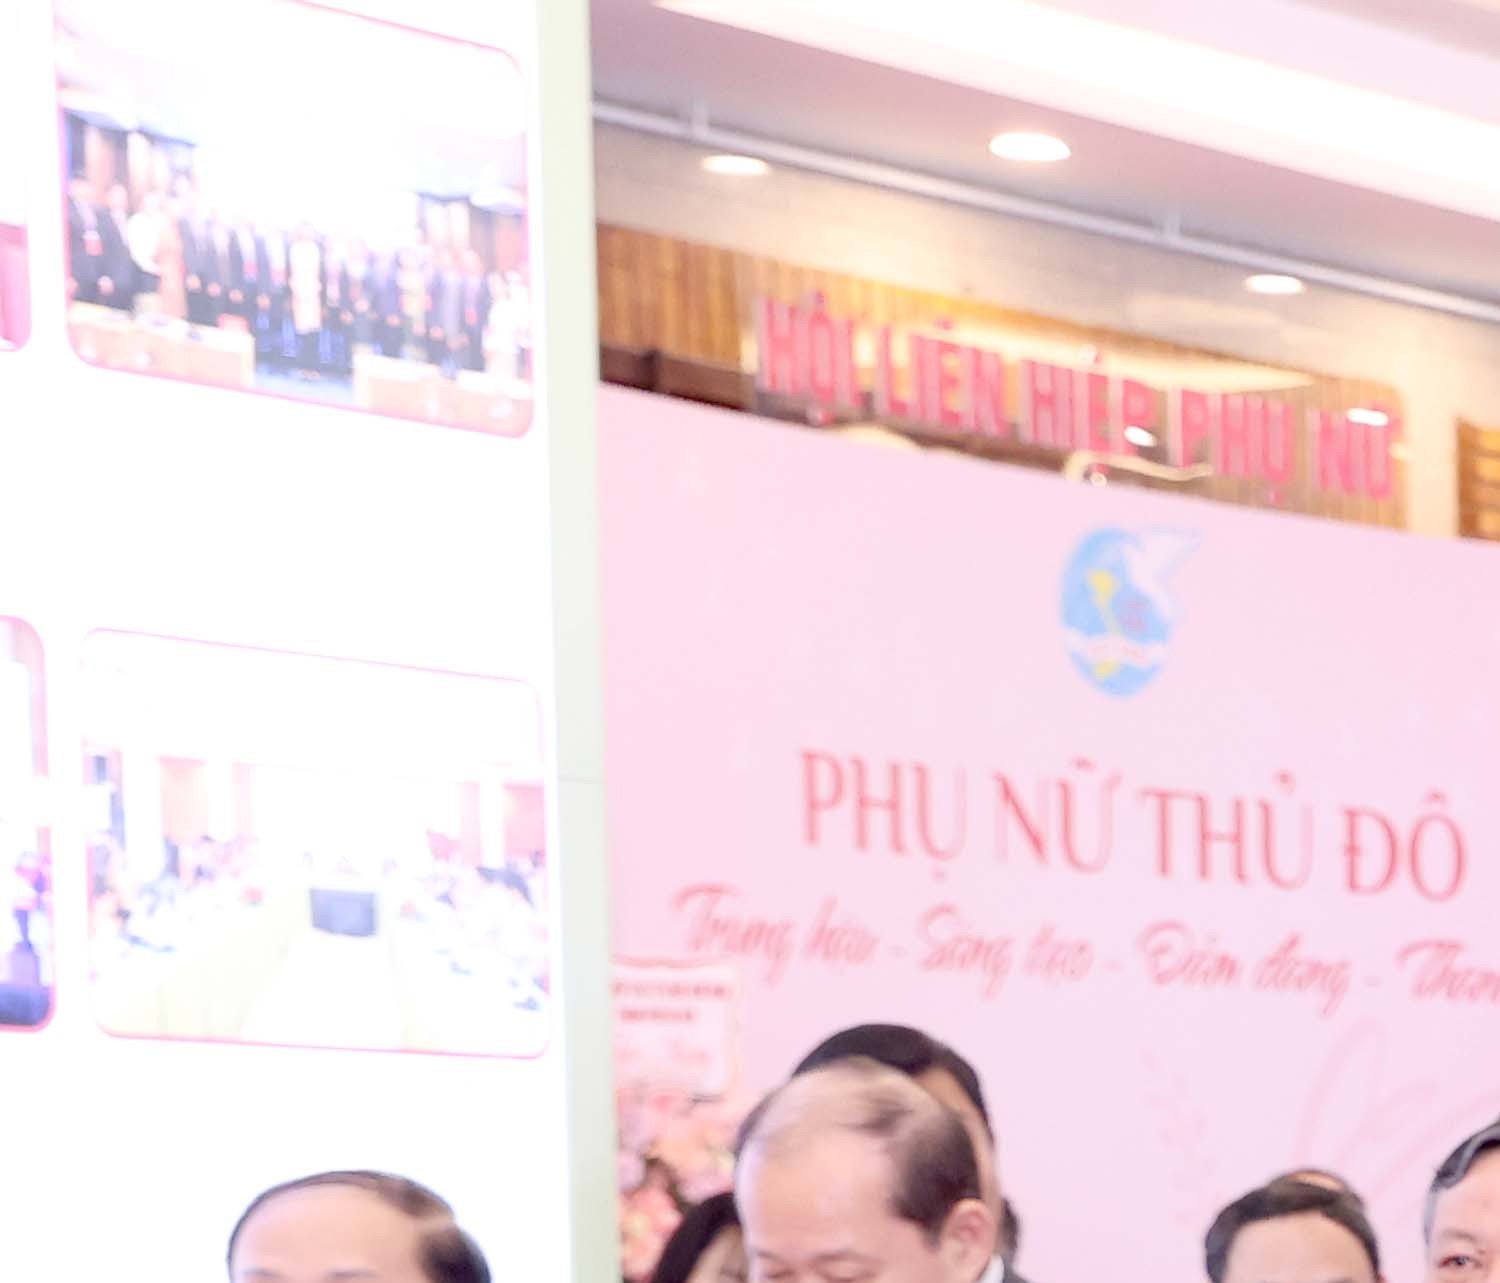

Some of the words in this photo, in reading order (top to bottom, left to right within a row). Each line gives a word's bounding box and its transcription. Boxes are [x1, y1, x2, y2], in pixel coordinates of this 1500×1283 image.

[801, 748, 966, 881] PHỤ
[994, 757, 1122, 873] NỮ
[1139, 769, 1314, 890] THỦ
[1341, 789, 1466, 902] ĐÔ
